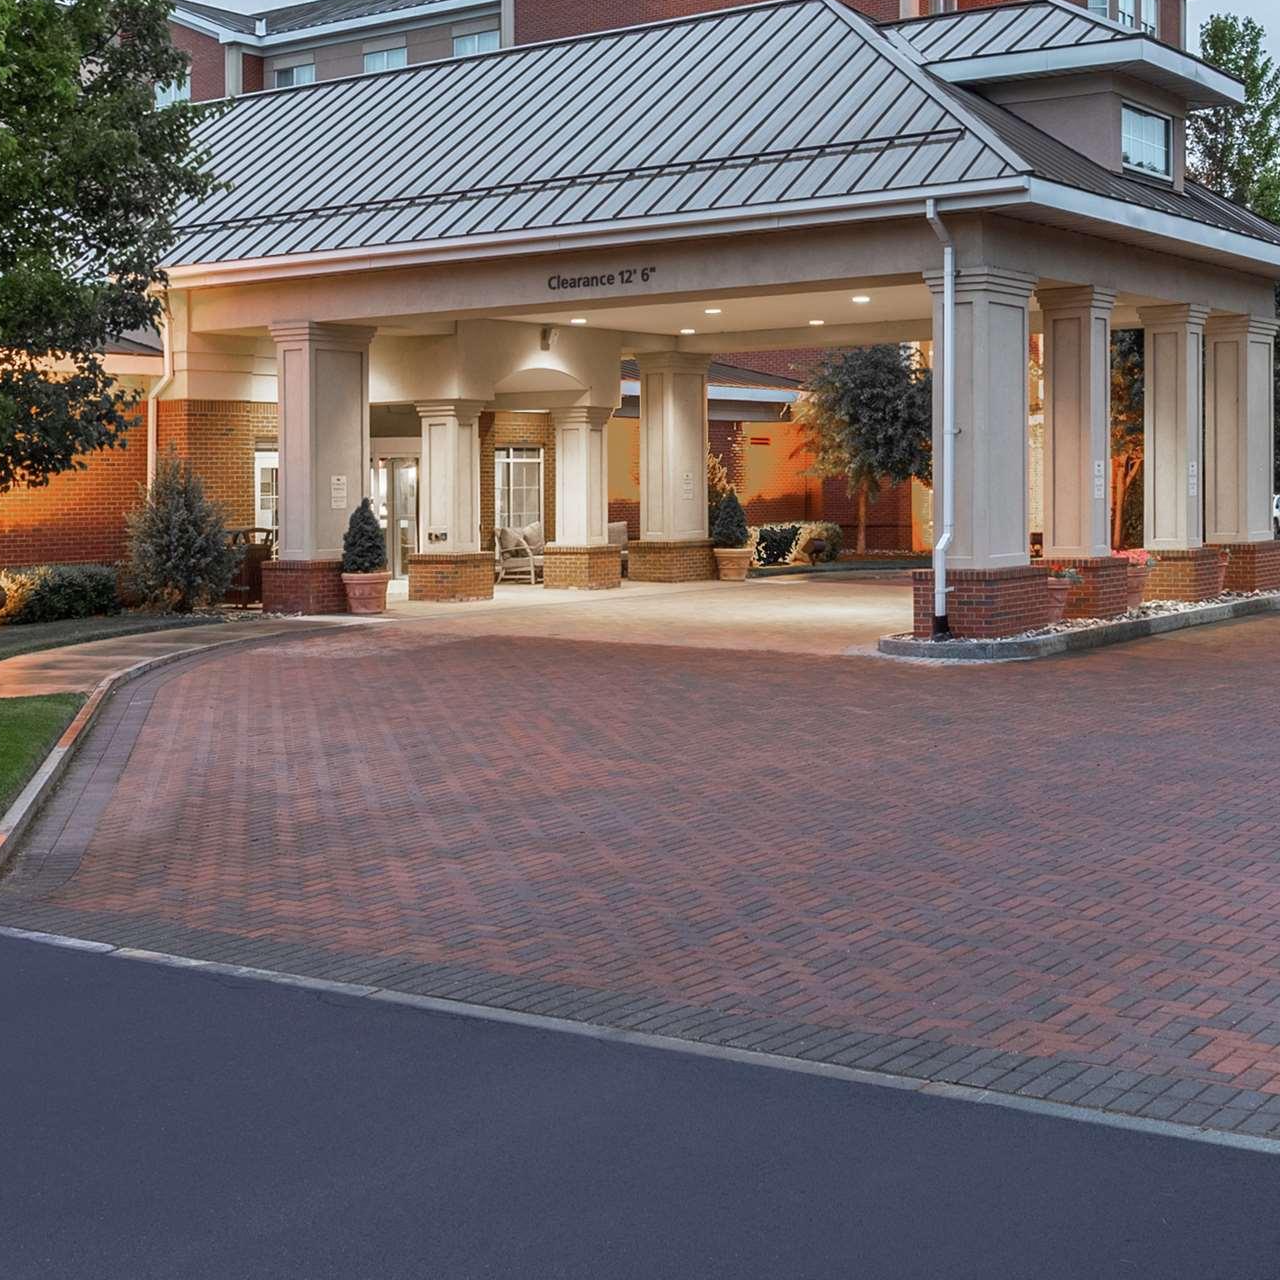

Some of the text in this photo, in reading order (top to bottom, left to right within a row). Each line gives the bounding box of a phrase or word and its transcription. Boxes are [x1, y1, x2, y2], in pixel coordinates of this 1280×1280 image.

[548, 267, 656, 290] Clearance 12' 6"
